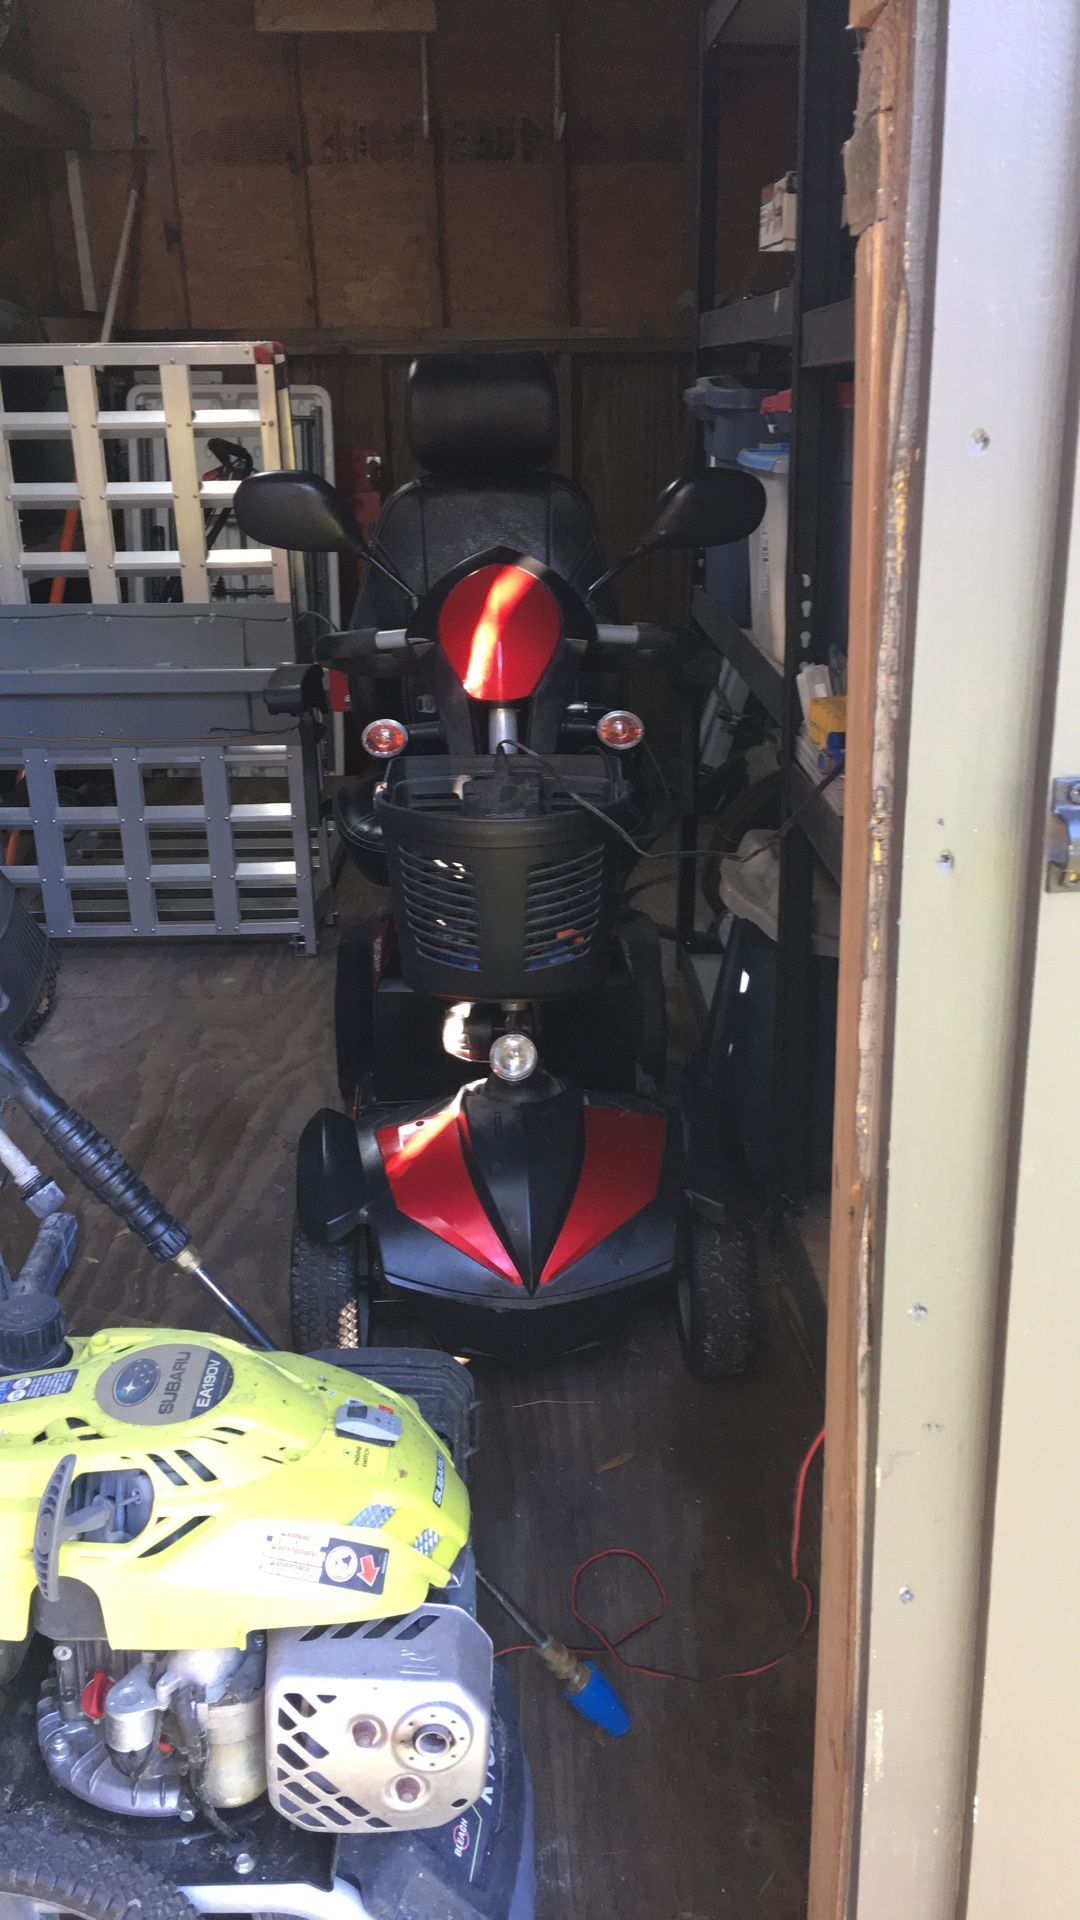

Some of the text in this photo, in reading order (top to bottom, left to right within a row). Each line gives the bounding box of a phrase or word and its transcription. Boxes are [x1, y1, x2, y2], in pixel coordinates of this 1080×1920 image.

[158, 1351, 191, 1415] SUBARU
[196, 1359, 221, 1408] EA190V
[454, 1818, 468, 1858] BLEACH
